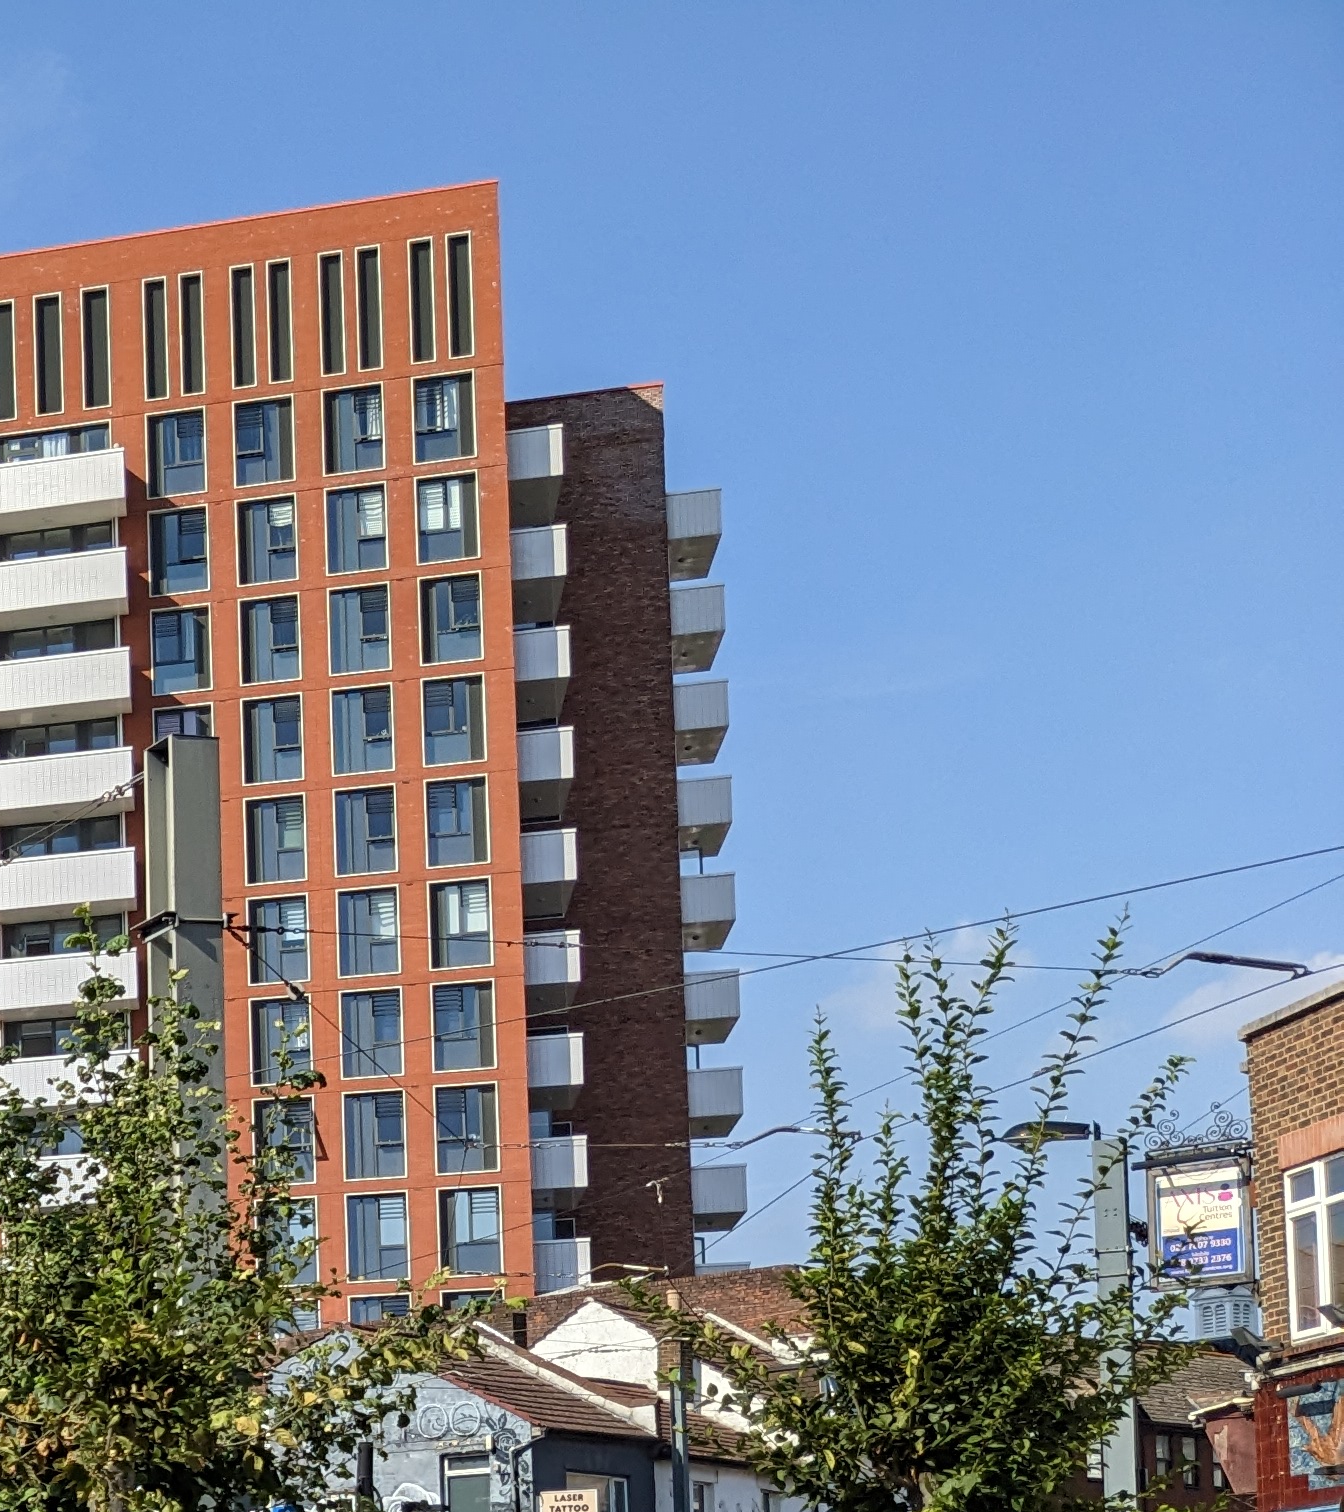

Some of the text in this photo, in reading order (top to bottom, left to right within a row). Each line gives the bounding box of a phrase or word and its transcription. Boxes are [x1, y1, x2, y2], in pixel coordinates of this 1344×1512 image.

[1203, 1204, 1232, 1214] Tuition
[1199, 1211, 1232, 1221] Centres
[554, 1494, 583, 1502] LASER
[549, 1504, 589, 1512] TATTOO
